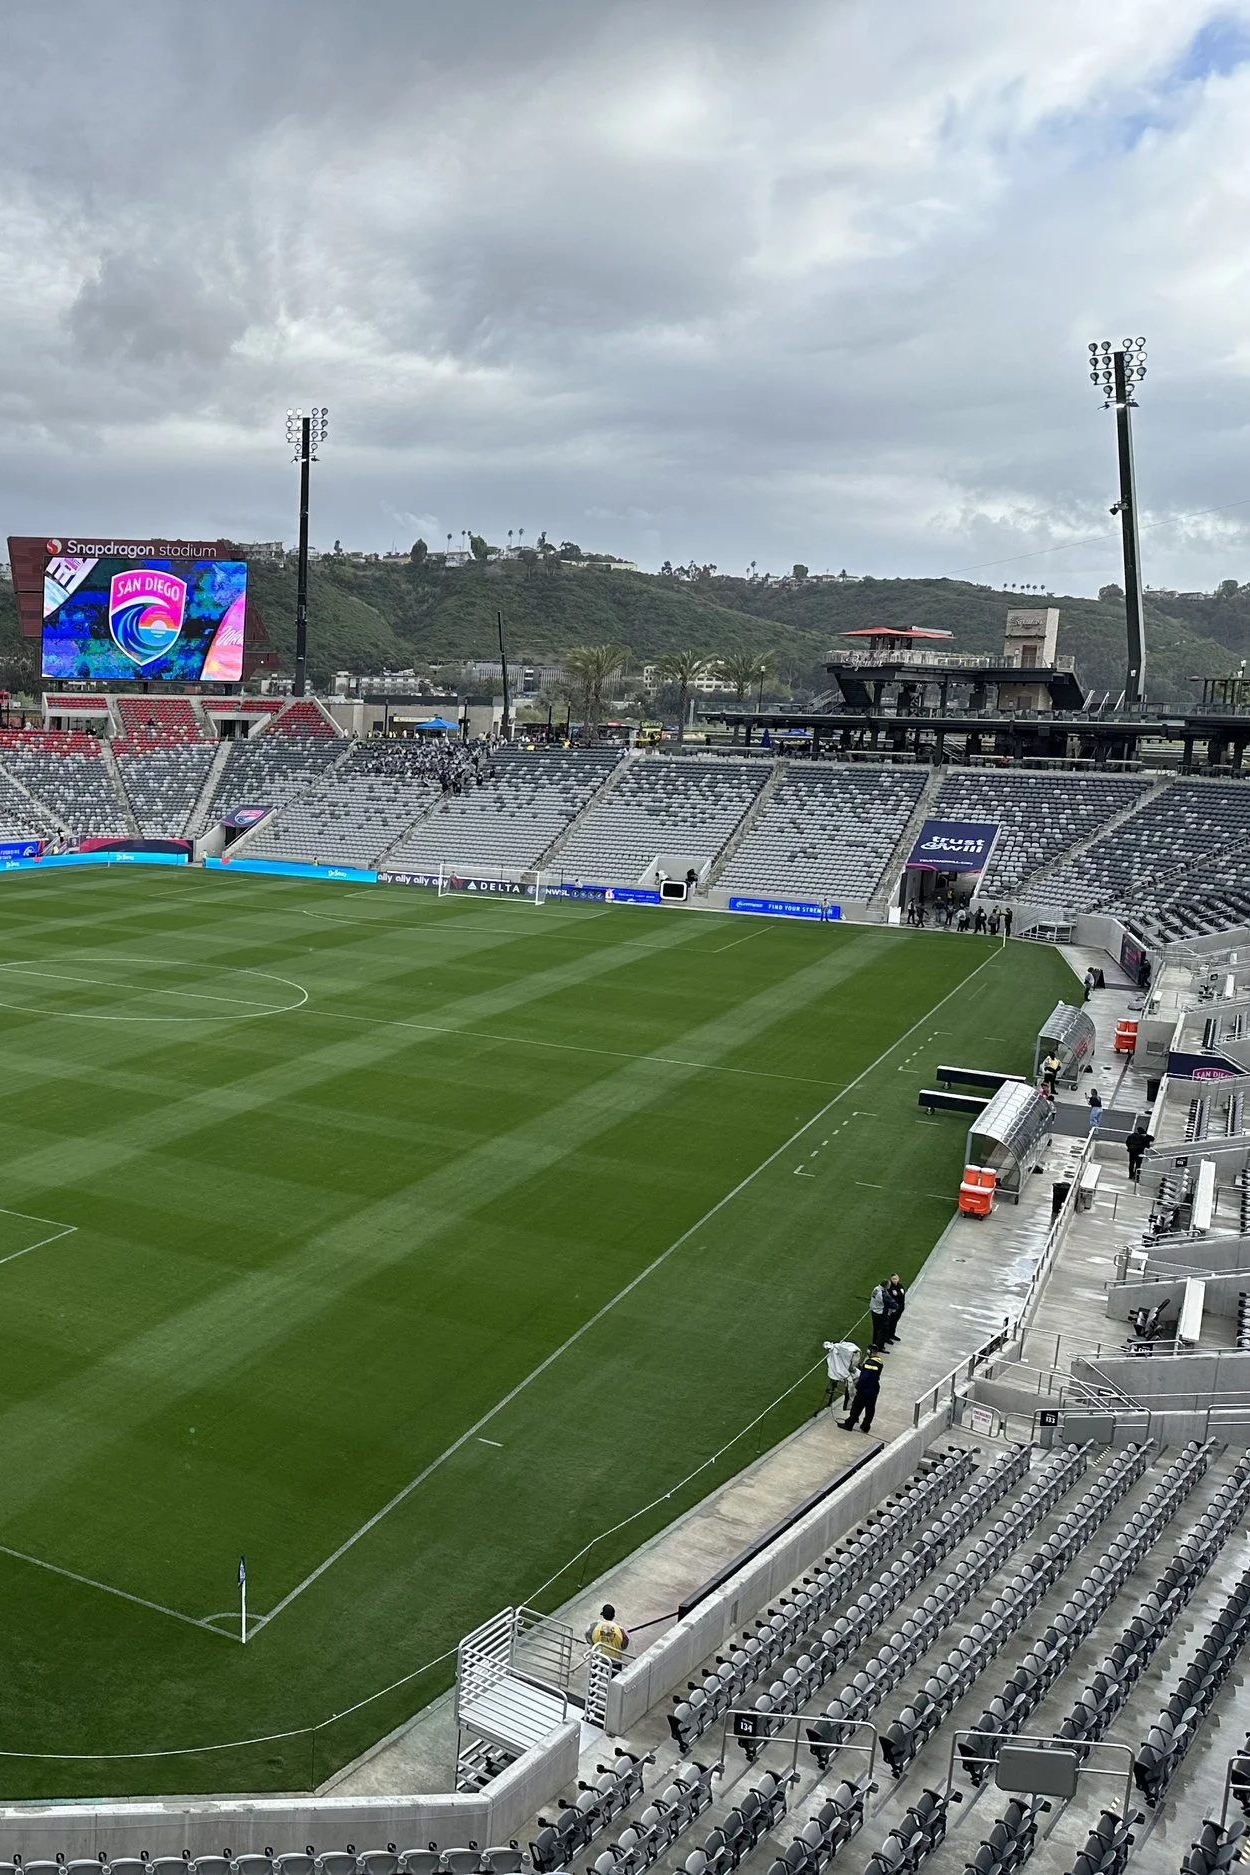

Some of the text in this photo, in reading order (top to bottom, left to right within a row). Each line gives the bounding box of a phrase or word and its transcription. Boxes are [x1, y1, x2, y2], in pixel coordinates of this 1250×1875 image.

[66, 540, 217, 558] Snapdragon stadium
[116, 575, 180, 601] SAN DIEGO
[932, 836, 985, 846] trust
[942, 845, 983, 853] will
[377, 872, 393, 884] ally
[395, 874, 411, 886] ally
[413, 875, 429, 887] ally
[480, 883, 520, 893] DELTA
[784, 905, 799, 913] YOUR
[1045, 1416, 1055, 1424] 133
[740, 1721, 753, 1733] 134
